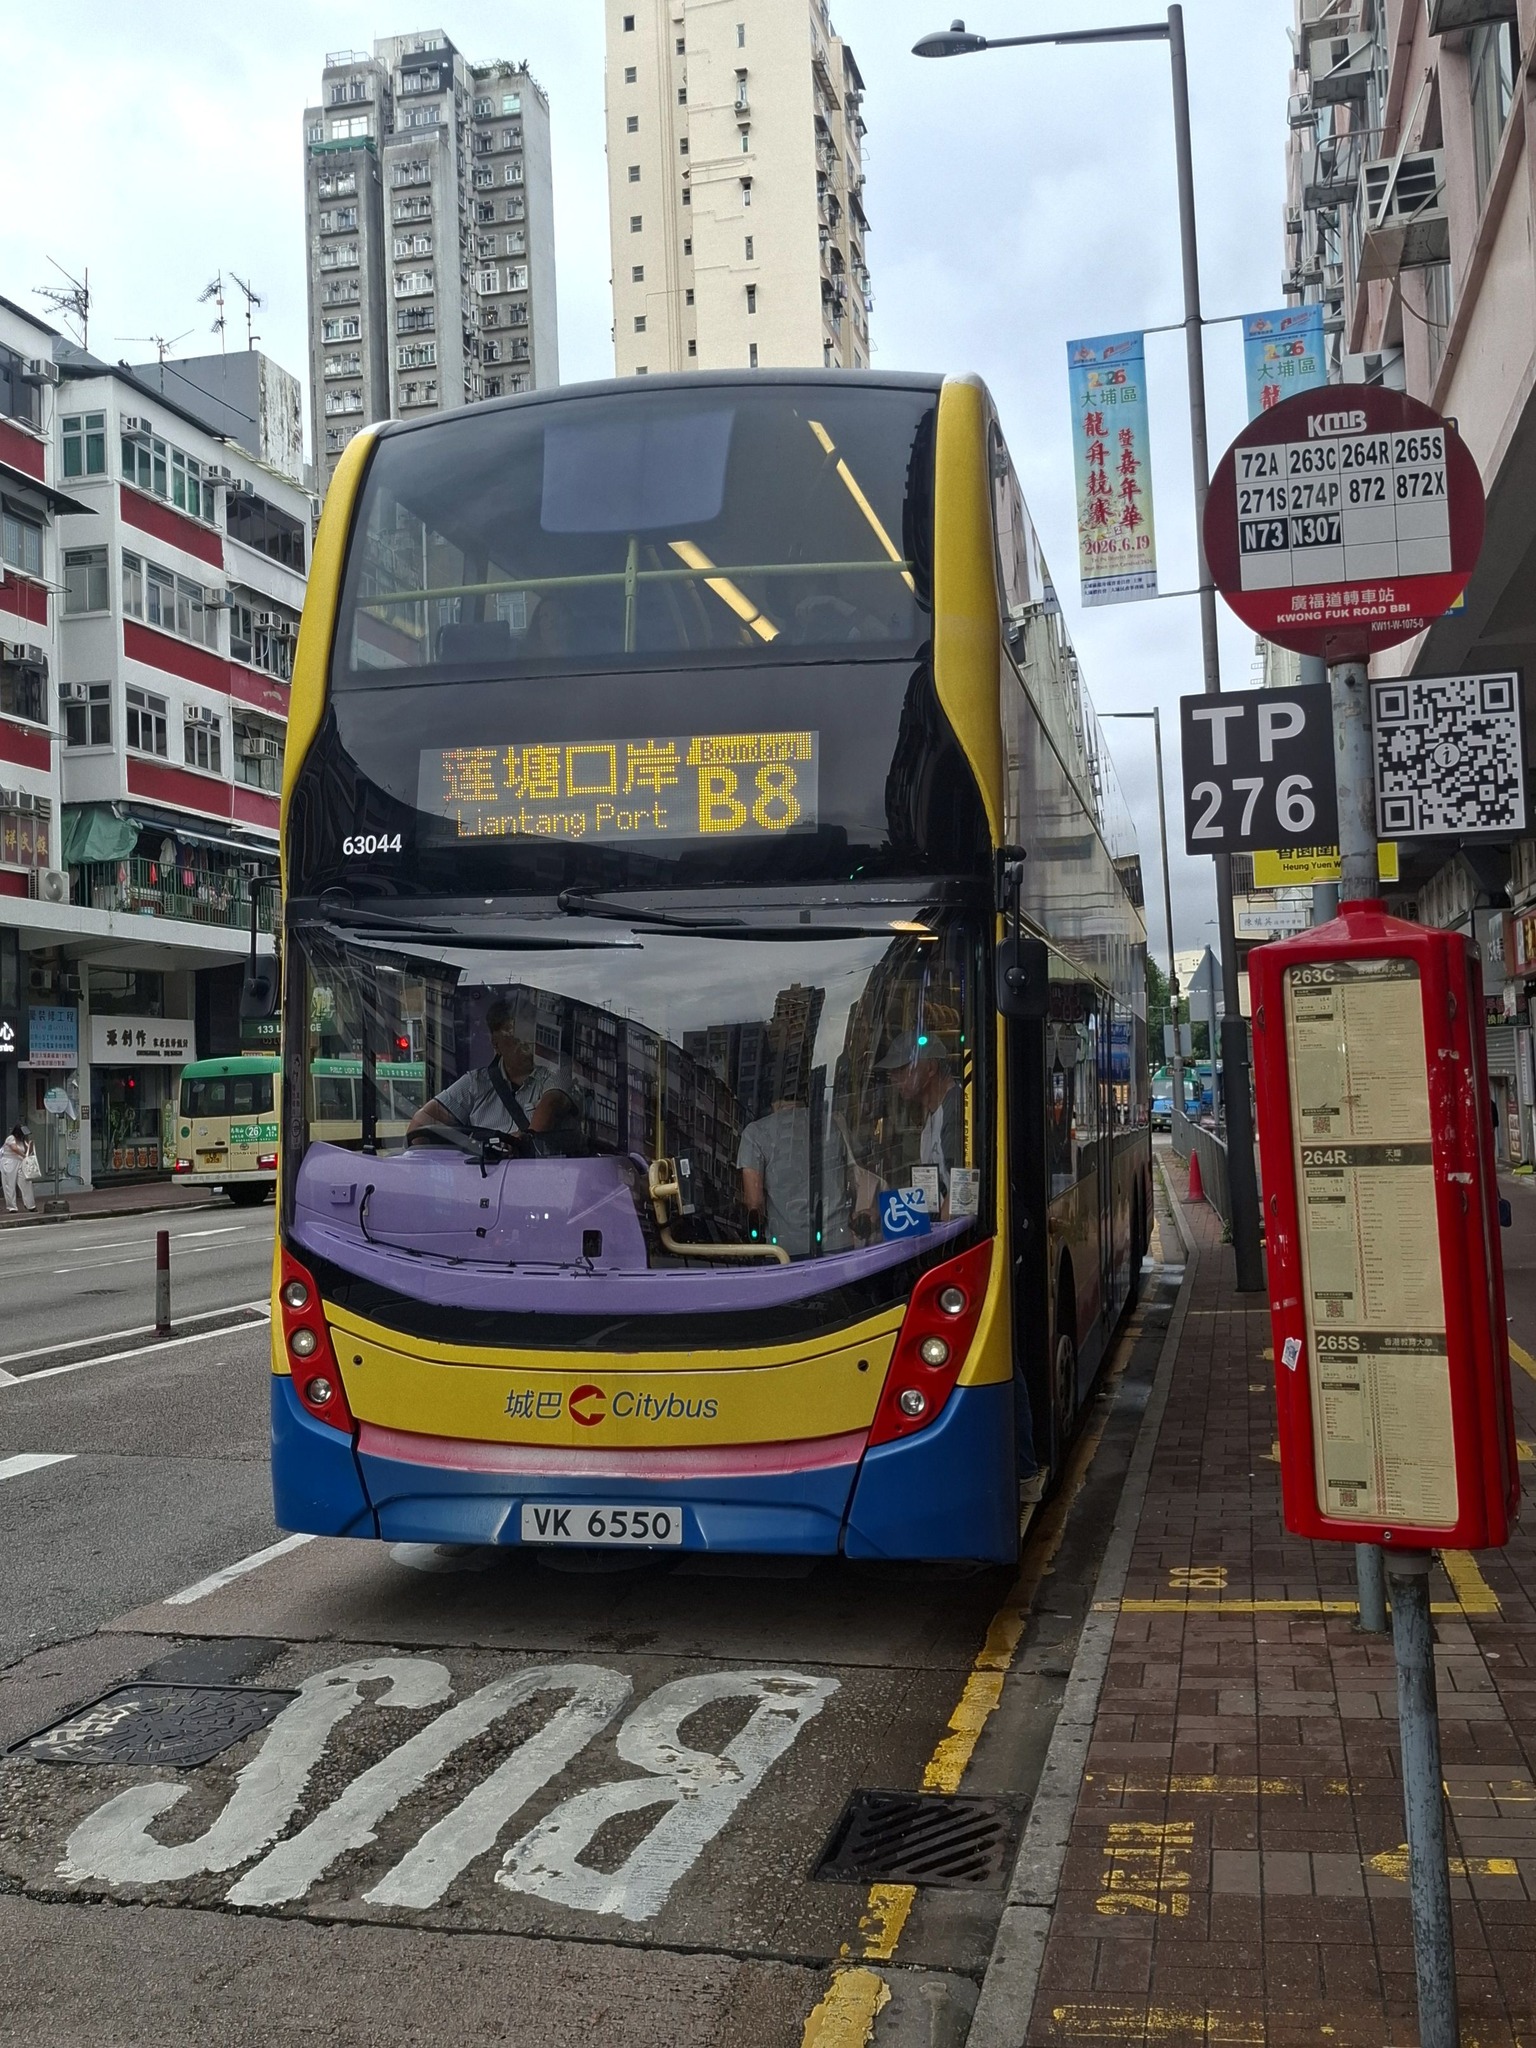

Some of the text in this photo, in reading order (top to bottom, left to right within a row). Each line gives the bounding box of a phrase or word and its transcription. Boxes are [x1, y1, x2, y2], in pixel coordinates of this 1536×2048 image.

[1257, 357, 1316, 381] 大埔區
[1081, 386, 1138, 408] 大埔區
[1307, 410, 1367, 438] KMB
[1241, 435, 1442, 479] 72A 263C 264R 265S
[1240, 471, 1445, 515] 271S 274P 872 872X
[1085, 535, 1150, 555] 2026.6.19
[1245, 516, 1341, 550] N73 N307
[1291, 587, 1395, 611] 廣福道轉車站
[1277, 603, 1411, 623] KWONG FUK ROAD BBI
[1192, 702, 1306, 766] TP
[442, 740, 681, 802] 蓮塘口岸
[699, 763, 800, 832] B8
[1190, 774, 1316, 840] 276
[457, 800, 669, 838] Liantang Port
[342, 833, 402, 856] 63044
[1283, 861, 1309, 872] Heung
[1311, 860, 1332, 870] Yuen
[1292, 968, 1335, 984] 263C
[257, 1024, 274, 1034] 133
[248, 1126, 259, 1136] 26
[1303, 1150, 1348, 1165] 264R
[905, 1188, 926, 1205] x2
[1317, 1335, 1360, 1351] 265S
[504, 1389, 563, 1419] 城巴
[612, 1391, 719, 1421] Citybus
[533, 1508, 671, 1540] VK 6550
[54, 1656, 843, 1924] BUS
